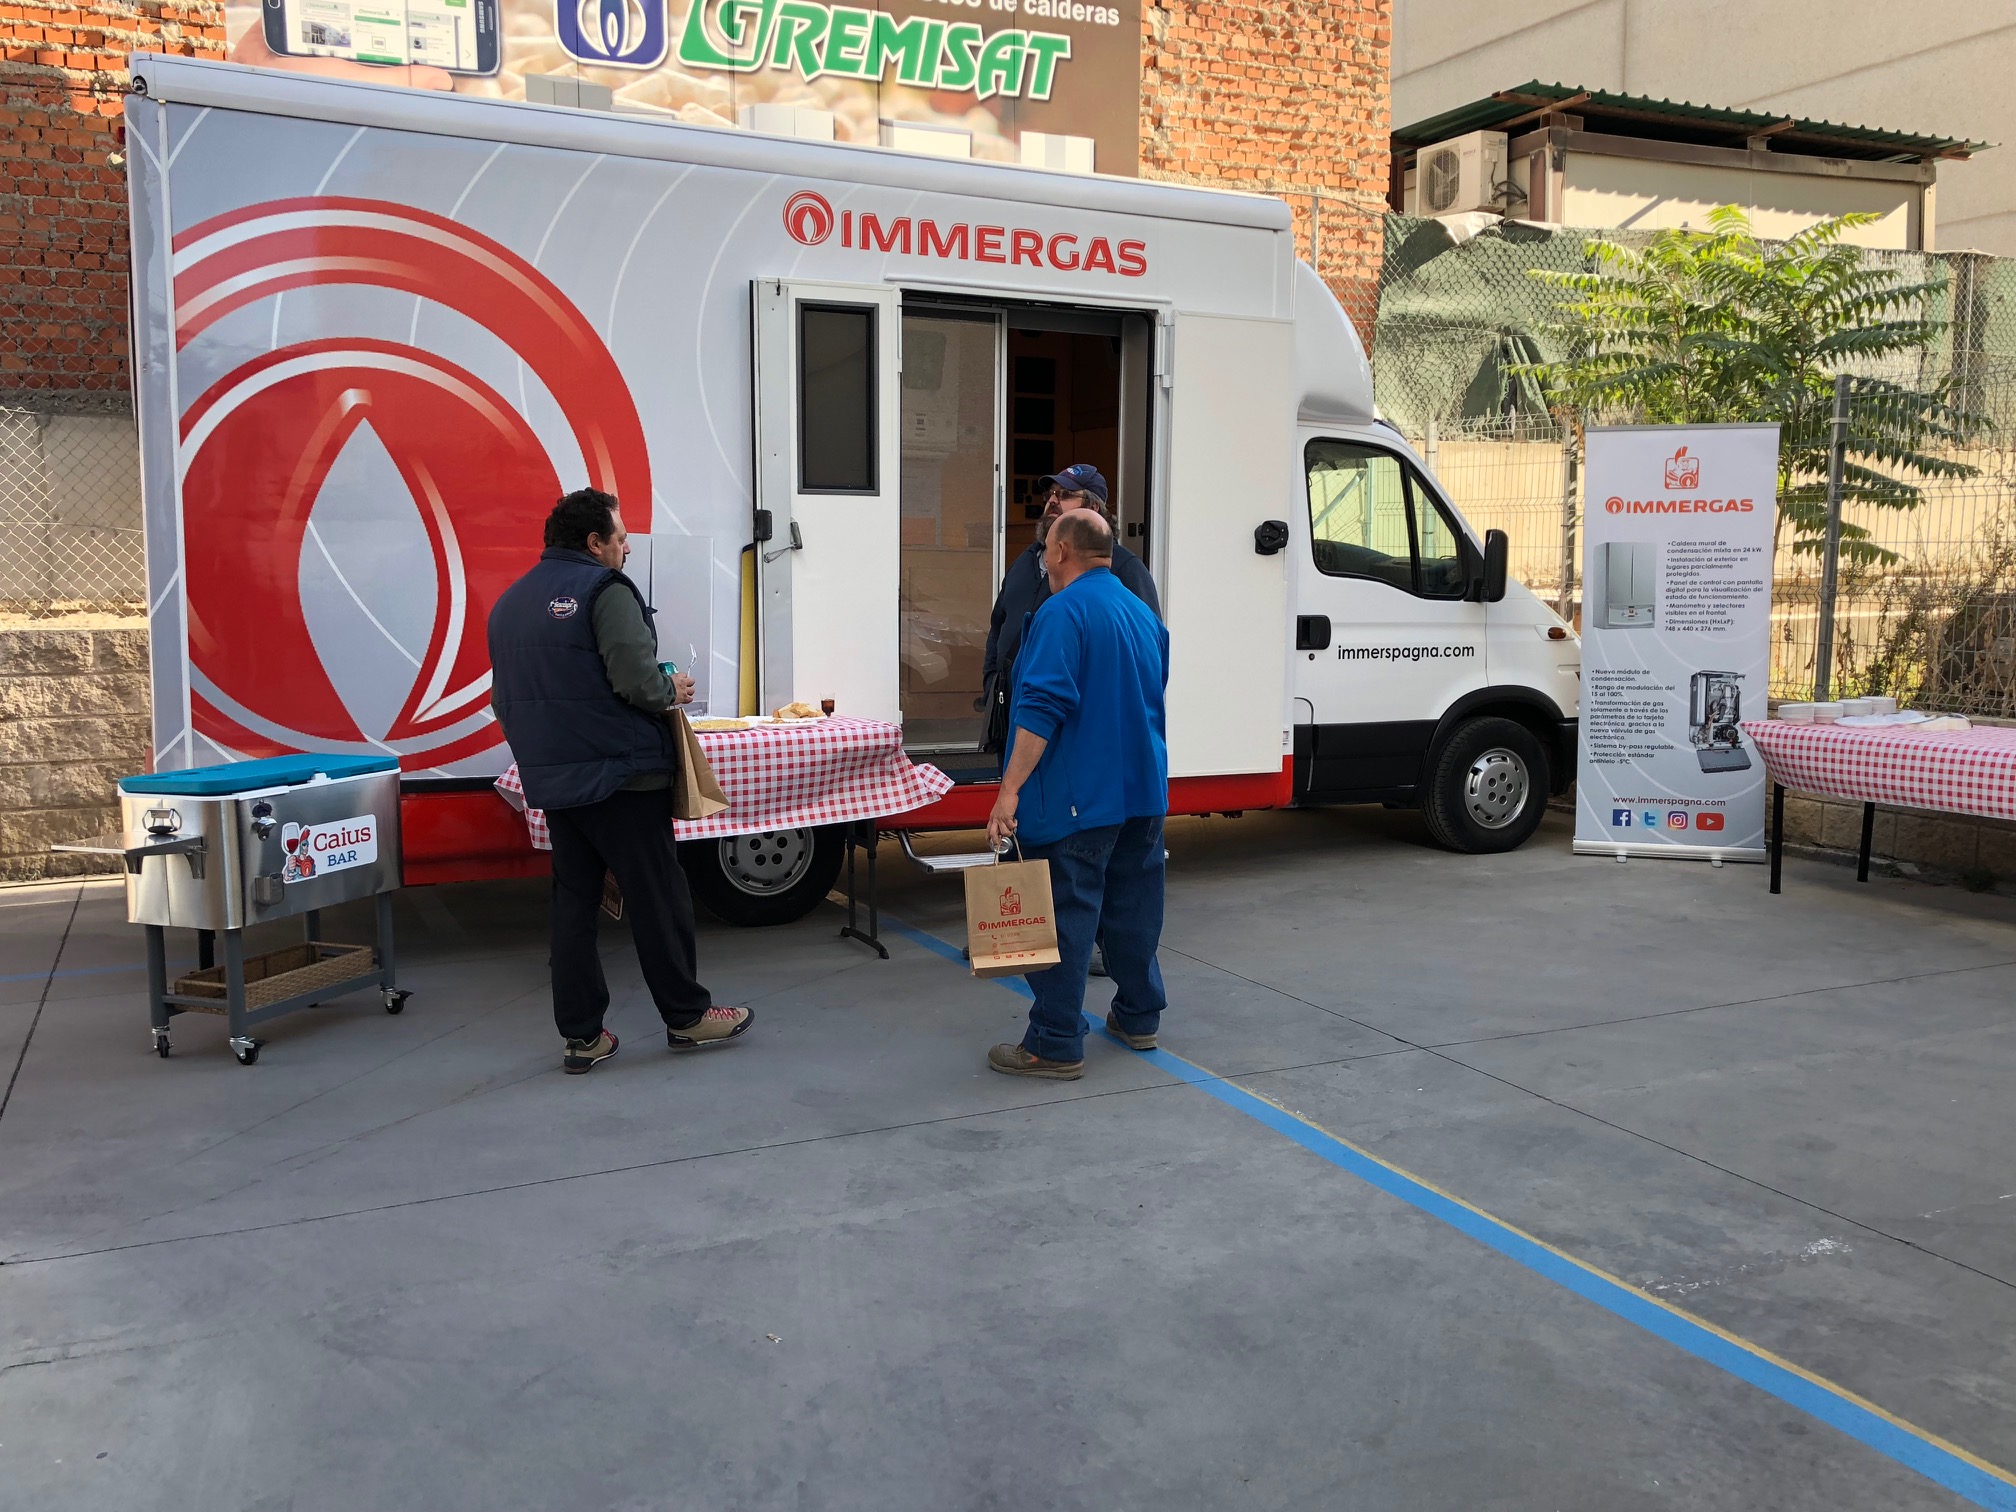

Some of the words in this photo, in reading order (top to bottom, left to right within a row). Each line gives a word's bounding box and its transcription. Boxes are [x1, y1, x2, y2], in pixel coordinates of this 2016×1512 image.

[477, 0, 486, 34] SAMSUNG
[1023, 0, 1120, 26] calderas
[678, 0, 1072, 100] GREMISAT
[841, 209, 1147, 277] IMMERGAS
[1626, 498, 1754, 514] IMMERGAS
[1338, 645, 1475, 662] immerspagna.com
[1613, 797, 1726, 806] www.immerspagna.com
[313, 826, 372, 852] Caius
[327, 849, 358, 867] BAR
[988, 916, 1046, 930] IMMERGAS
